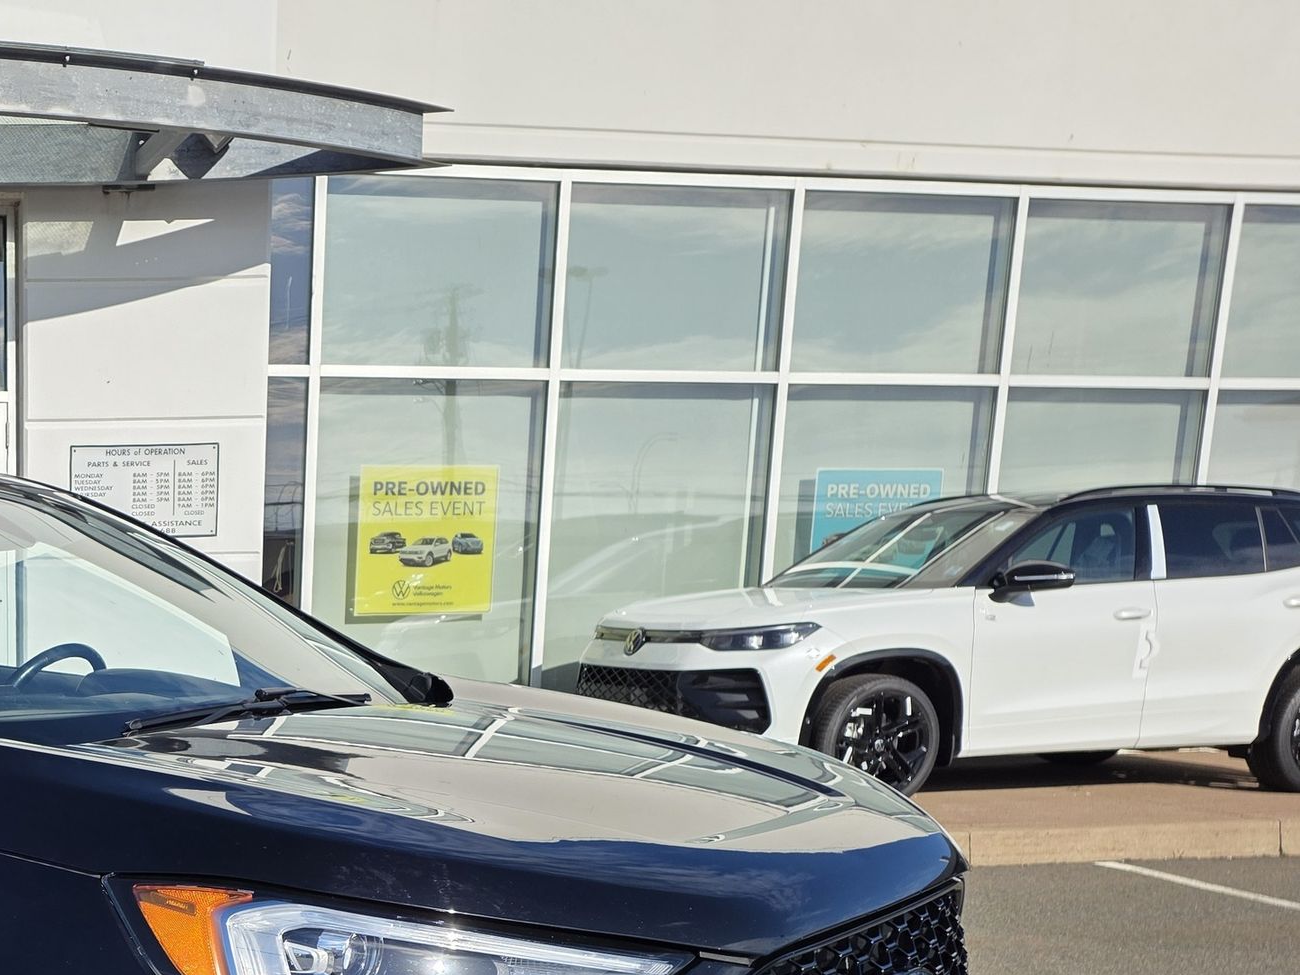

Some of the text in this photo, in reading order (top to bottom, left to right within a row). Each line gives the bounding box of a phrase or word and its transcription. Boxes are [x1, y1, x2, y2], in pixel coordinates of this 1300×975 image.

[105, 448, 186, 457] HOURS of OPERATION
[373, 481, 486, 496] PRE-OWNED
[827, 483, 931, 498] PRE-OWNED
[372, 501, 486, 516] SALES EVENT
[826, 502, 873, 518] SALES
